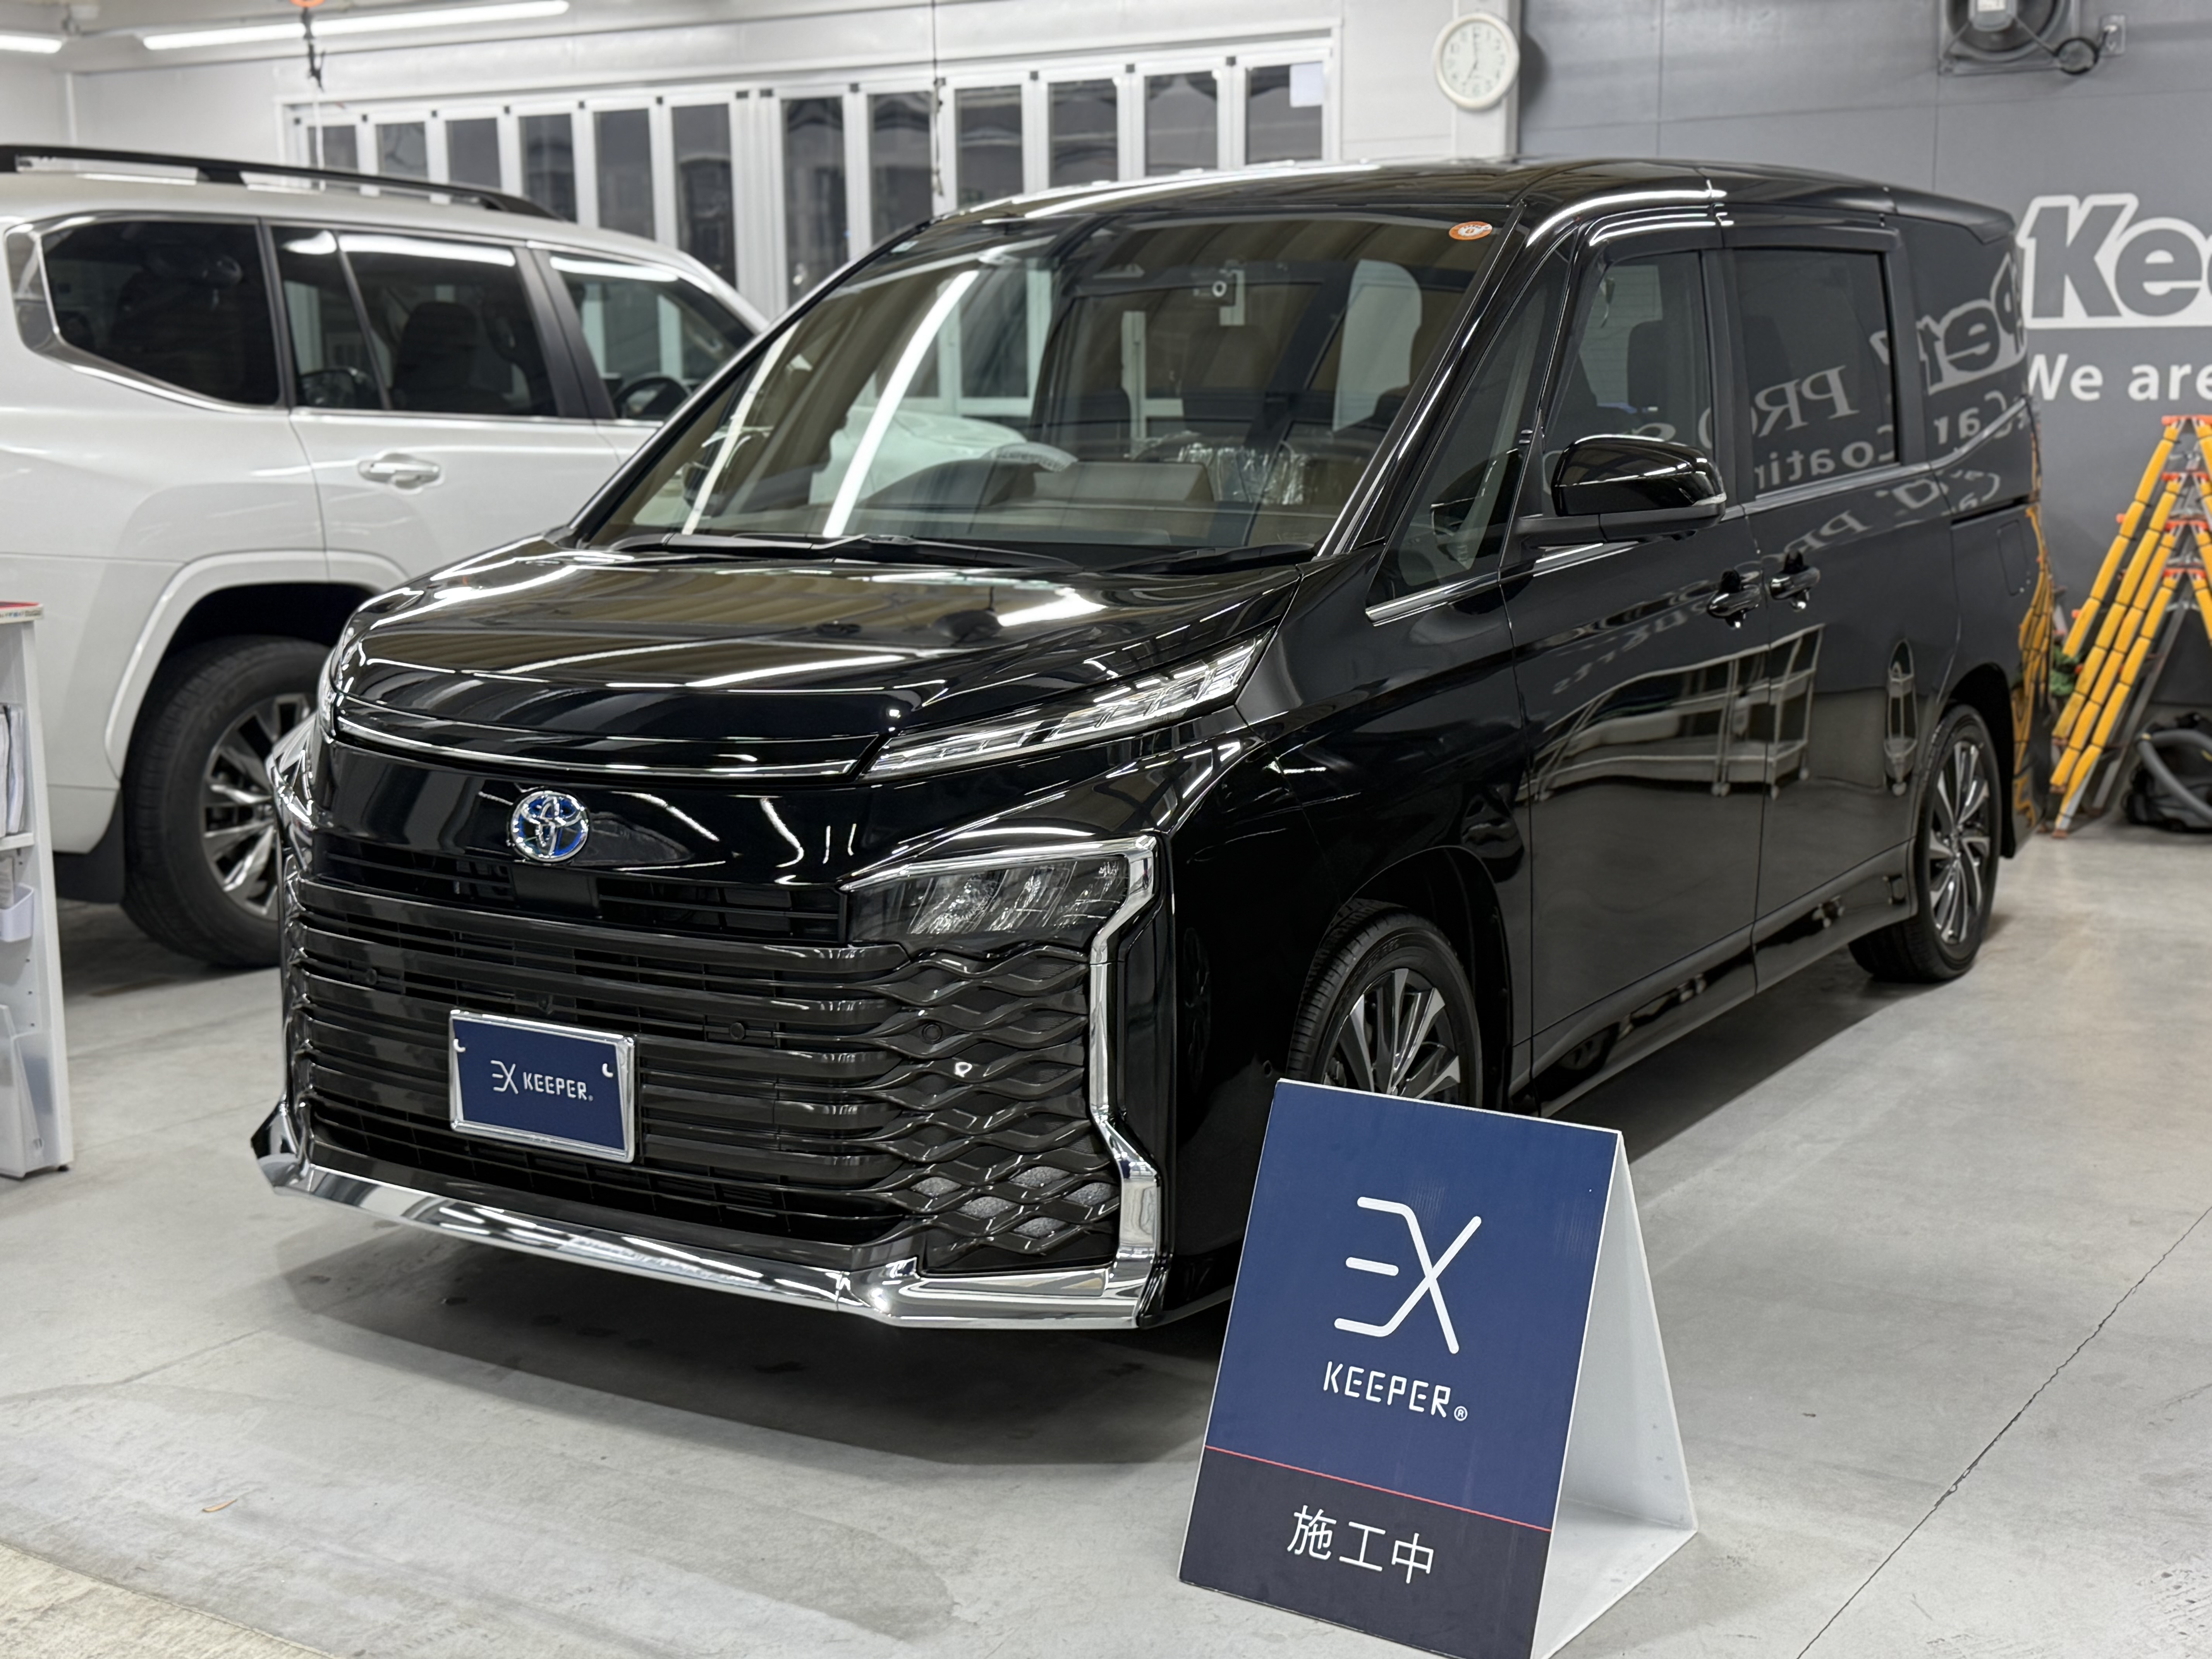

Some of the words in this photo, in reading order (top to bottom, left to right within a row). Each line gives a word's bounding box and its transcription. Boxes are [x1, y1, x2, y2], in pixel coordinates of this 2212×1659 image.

[2016, 193, 2212, 329] Ke
[2028, 354, 2103, 401] We
[1287, 1505, 1434, 1584] 施工中
